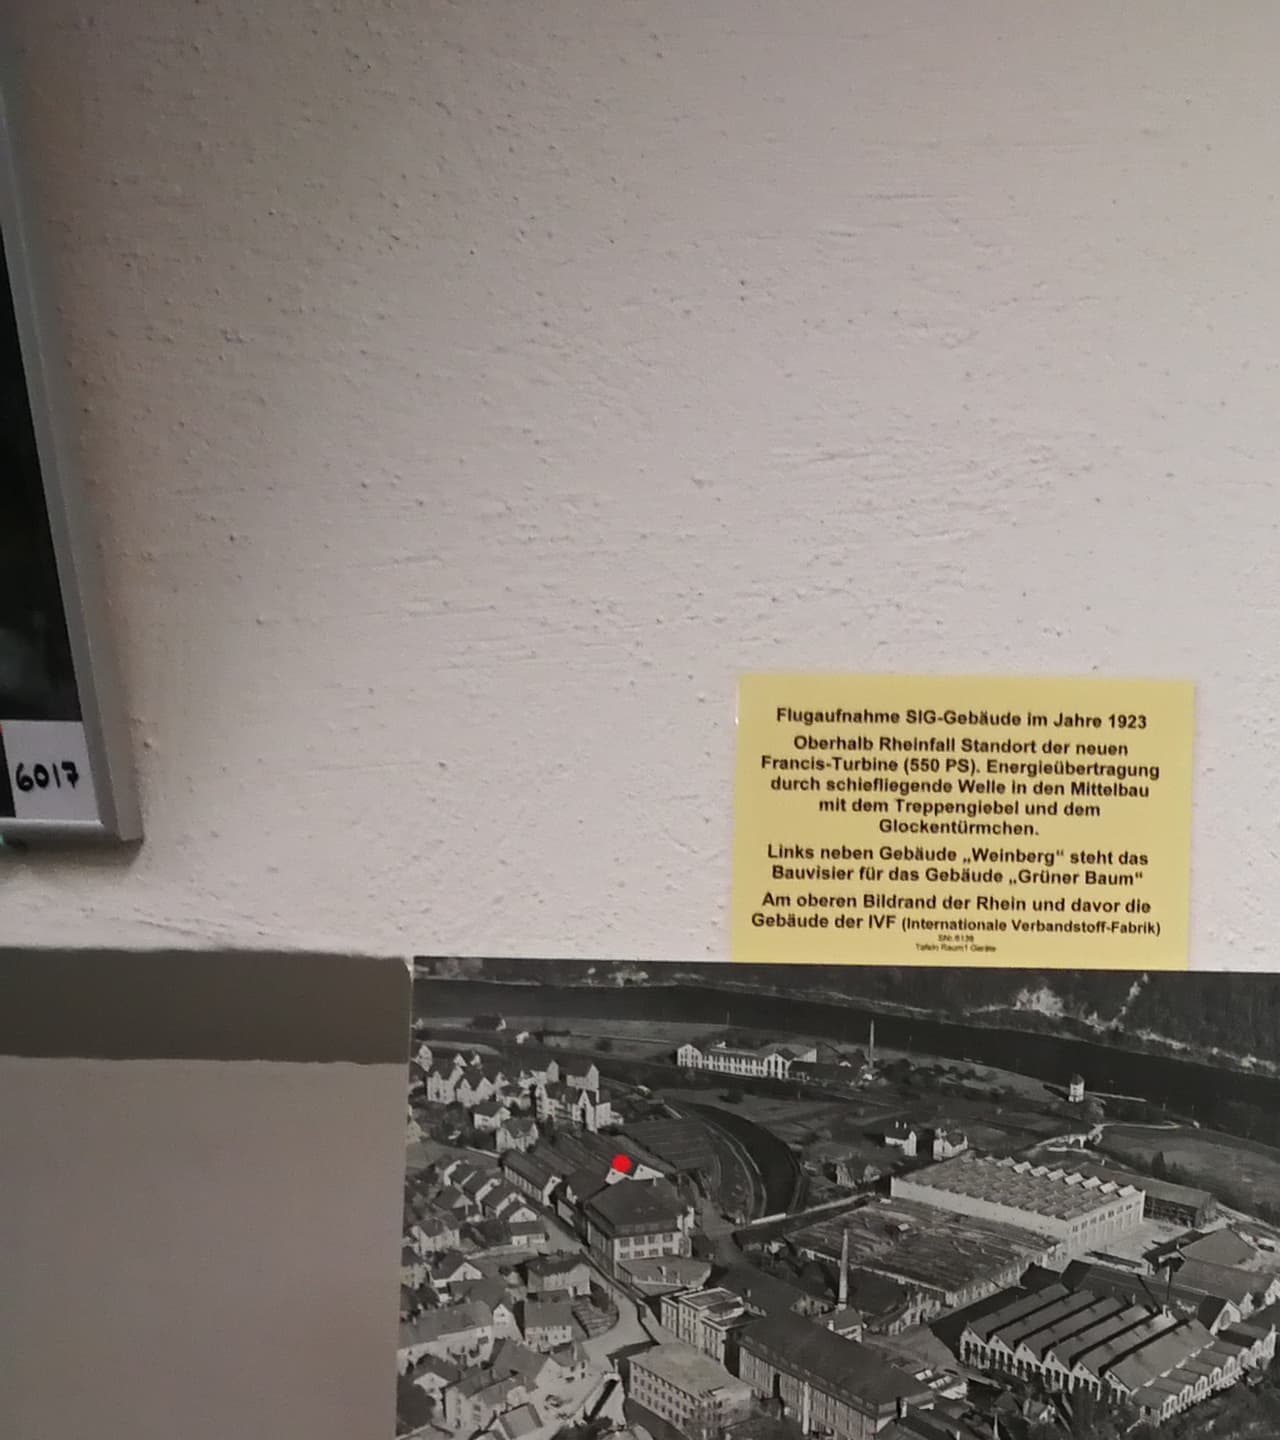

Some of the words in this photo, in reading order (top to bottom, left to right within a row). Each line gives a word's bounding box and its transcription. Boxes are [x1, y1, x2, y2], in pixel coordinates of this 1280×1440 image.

[776, 706, 901, 728] Flugaufnahme
[905, 708, 1022, 727] SIG-Gebäude
[1026, 711, 1048, 727] im
[1052, 711, 1103, 729] Jahre
[1108, 713, 1148, 730] 1923
[793, 734, 874, 751] Oberhalb
[878, 735, 956, 753] Rheinfall
[960, 737, 1038, 755] Standort
[1041, 739, 1071, 755] der
[1075, 743, 1129, 756] neuen
[15, 761, 80, 792] 6017
[760, 754, 899, 773] Francis-Turbine
[903, 757, 941, 776] (550
[945, 758, 981, 777] PS).
[986, 758, 1160, 782] Energieübertragung
[770, 775, 821, 792] durch
[825, 776, 954, 798] schiefliegende
[957, 778, 1007, 795] Welle
[1011, 779, 1028, 795] in
[1032, 780, 1065, 796] den
[1070, 780, 1150, 798] Mittelbau
[818, 796, 847, 813] mit
[851, 797, 889, 814] dem
[893, 797, 1020, 819] Treppengiebel
[1024, 800, 1059, 816] und
[1063, 800, 1101, 817] dem
[878, 817, 1040, 837] Glockentürmchen.
[767, 843, 815, 860] Links
[819, 844, 874, 860] neben
[878, 844, 958, 863] Gebäude
[1069, 848, 1114, 866] steht
[1117, 850, 1149, 867] das
[771, 864, 855, 881] Bauvisier
[858, 865, 885, 882] für
[888, 866, 920, 882] das
[924, 866, 1004, 883] Gebäude
[761, 891, 792, 908] Am
[796, 891, 858, 909] oberen
[862, 892, 937, 910] Bildrand
[941, 894, 972, 911] der
[976, 895, 1027, 912] Rhein
[1032, 897, 1066, 912] und
[1070, 896, 1122, 913] davor
[1124, 897, 1152, 914] die
[751, 912, 830, 929] Gebäude
[834, 913, 865, 929] der
[868, 913, 897, 930] IVF
[901, 916, 1008, 934] (Internationale
[1010, 918, 1161, 937] Verbandstoff-Fabrik)
